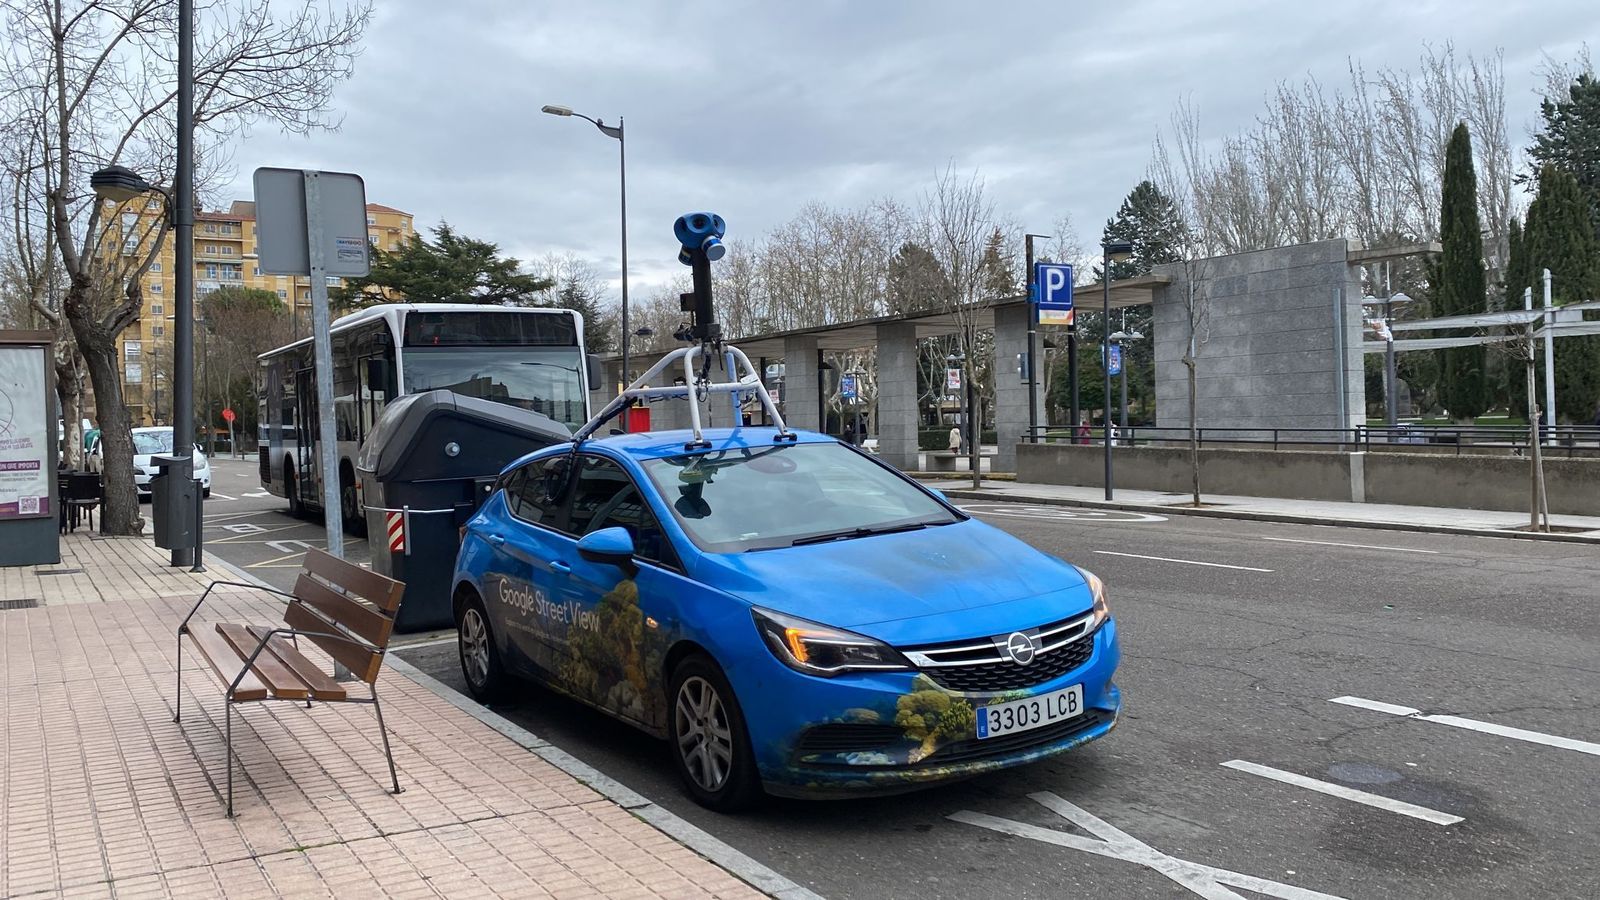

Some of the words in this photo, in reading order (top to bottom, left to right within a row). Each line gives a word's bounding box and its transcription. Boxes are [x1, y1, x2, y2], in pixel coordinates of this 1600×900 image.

[1046, 268, 1065, 302] P
[499, 578, 534, 616] Google
[535, 590, 570, 624] Street
[569, 600, 600, 632] View
[990, 701, 1041, 732] 3303
[1047, 690, 1077, 719] LCB
